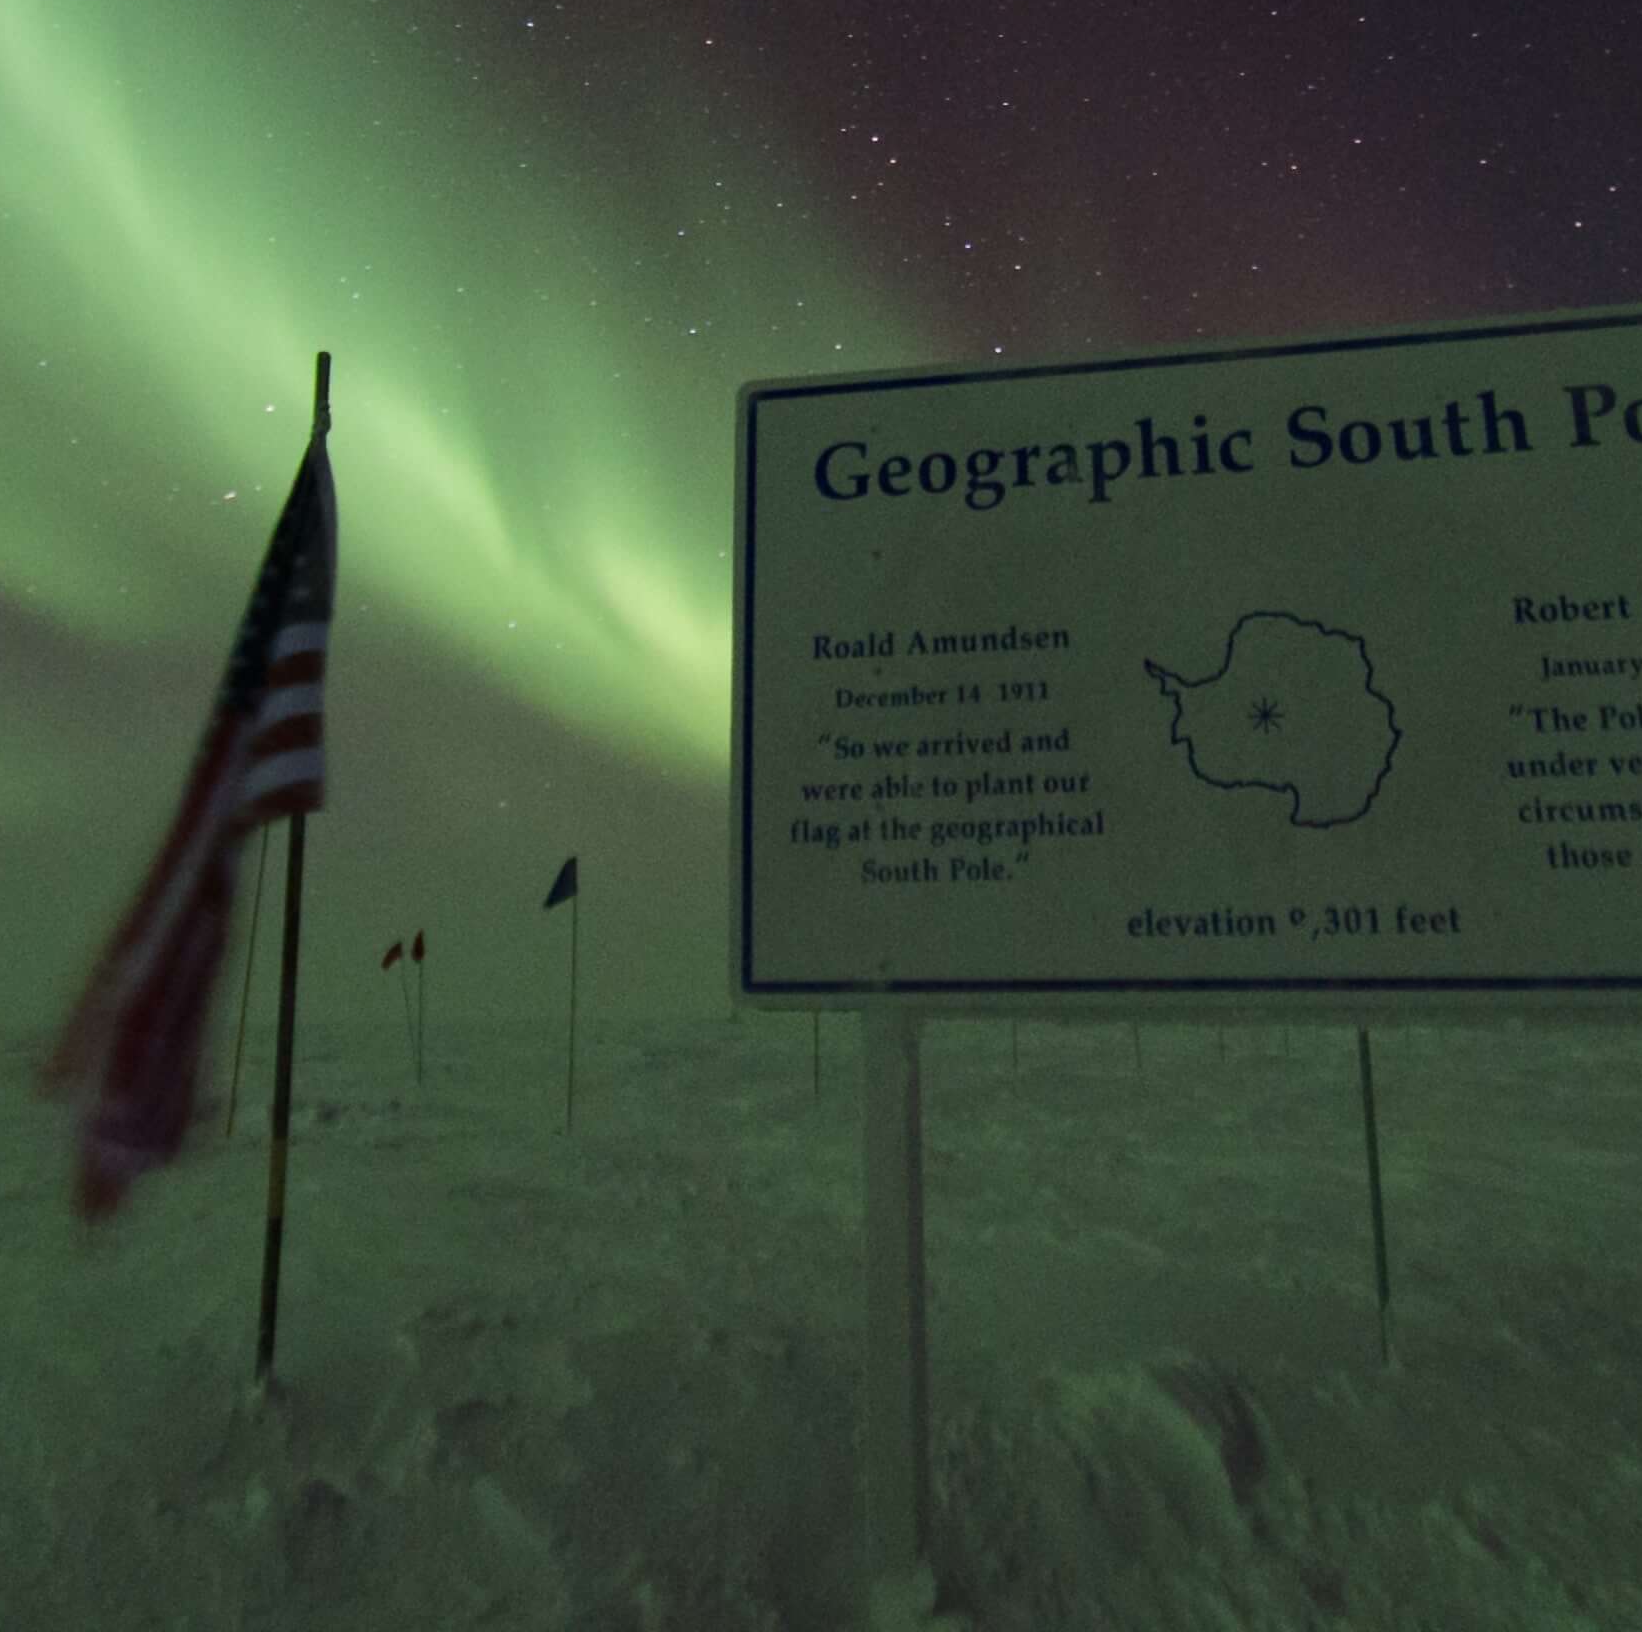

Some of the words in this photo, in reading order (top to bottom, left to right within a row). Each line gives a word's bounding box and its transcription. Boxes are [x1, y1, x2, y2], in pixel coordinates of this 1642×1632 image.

[813, 414, 1255, 511] Geographic
[1287, 391, 1535, 469] South
[1512, 594, 1631, 625] Robert
[812, 631, 895, 660] Roald
[907, 625, 1071, 656] Amundsen
[835, 685, 948, 709] December
[998, 681, 1049, 702] 1911
[1508, 702, 1589, 735] "The
[817, 732, 865, 760] "So
[873, 740, 909, 758] we
[916, 727, 1012, 756] arrived
[1020, 727, 1071, 753] and
[1508, 750, 1598, 779] under
[801, 783, 863, 801] were
[871, 775, 924, 800] able
[931, 775, 958, 798] to
[965, 771, 1035, 803] plant
[790, 818, 841, 849] flag
[847, 819, 871, 842] at
[879, 816, 922, 841] the
[930, 811, 1105, 846] geographical
[860, 857, 938, 884] South
[949, 851, 1030, 882] Pole."
[1546, 841, 1633, 870] those
[1126, 906, 1277, 938] elevation
[1396, 904, 1461, 935] feet
